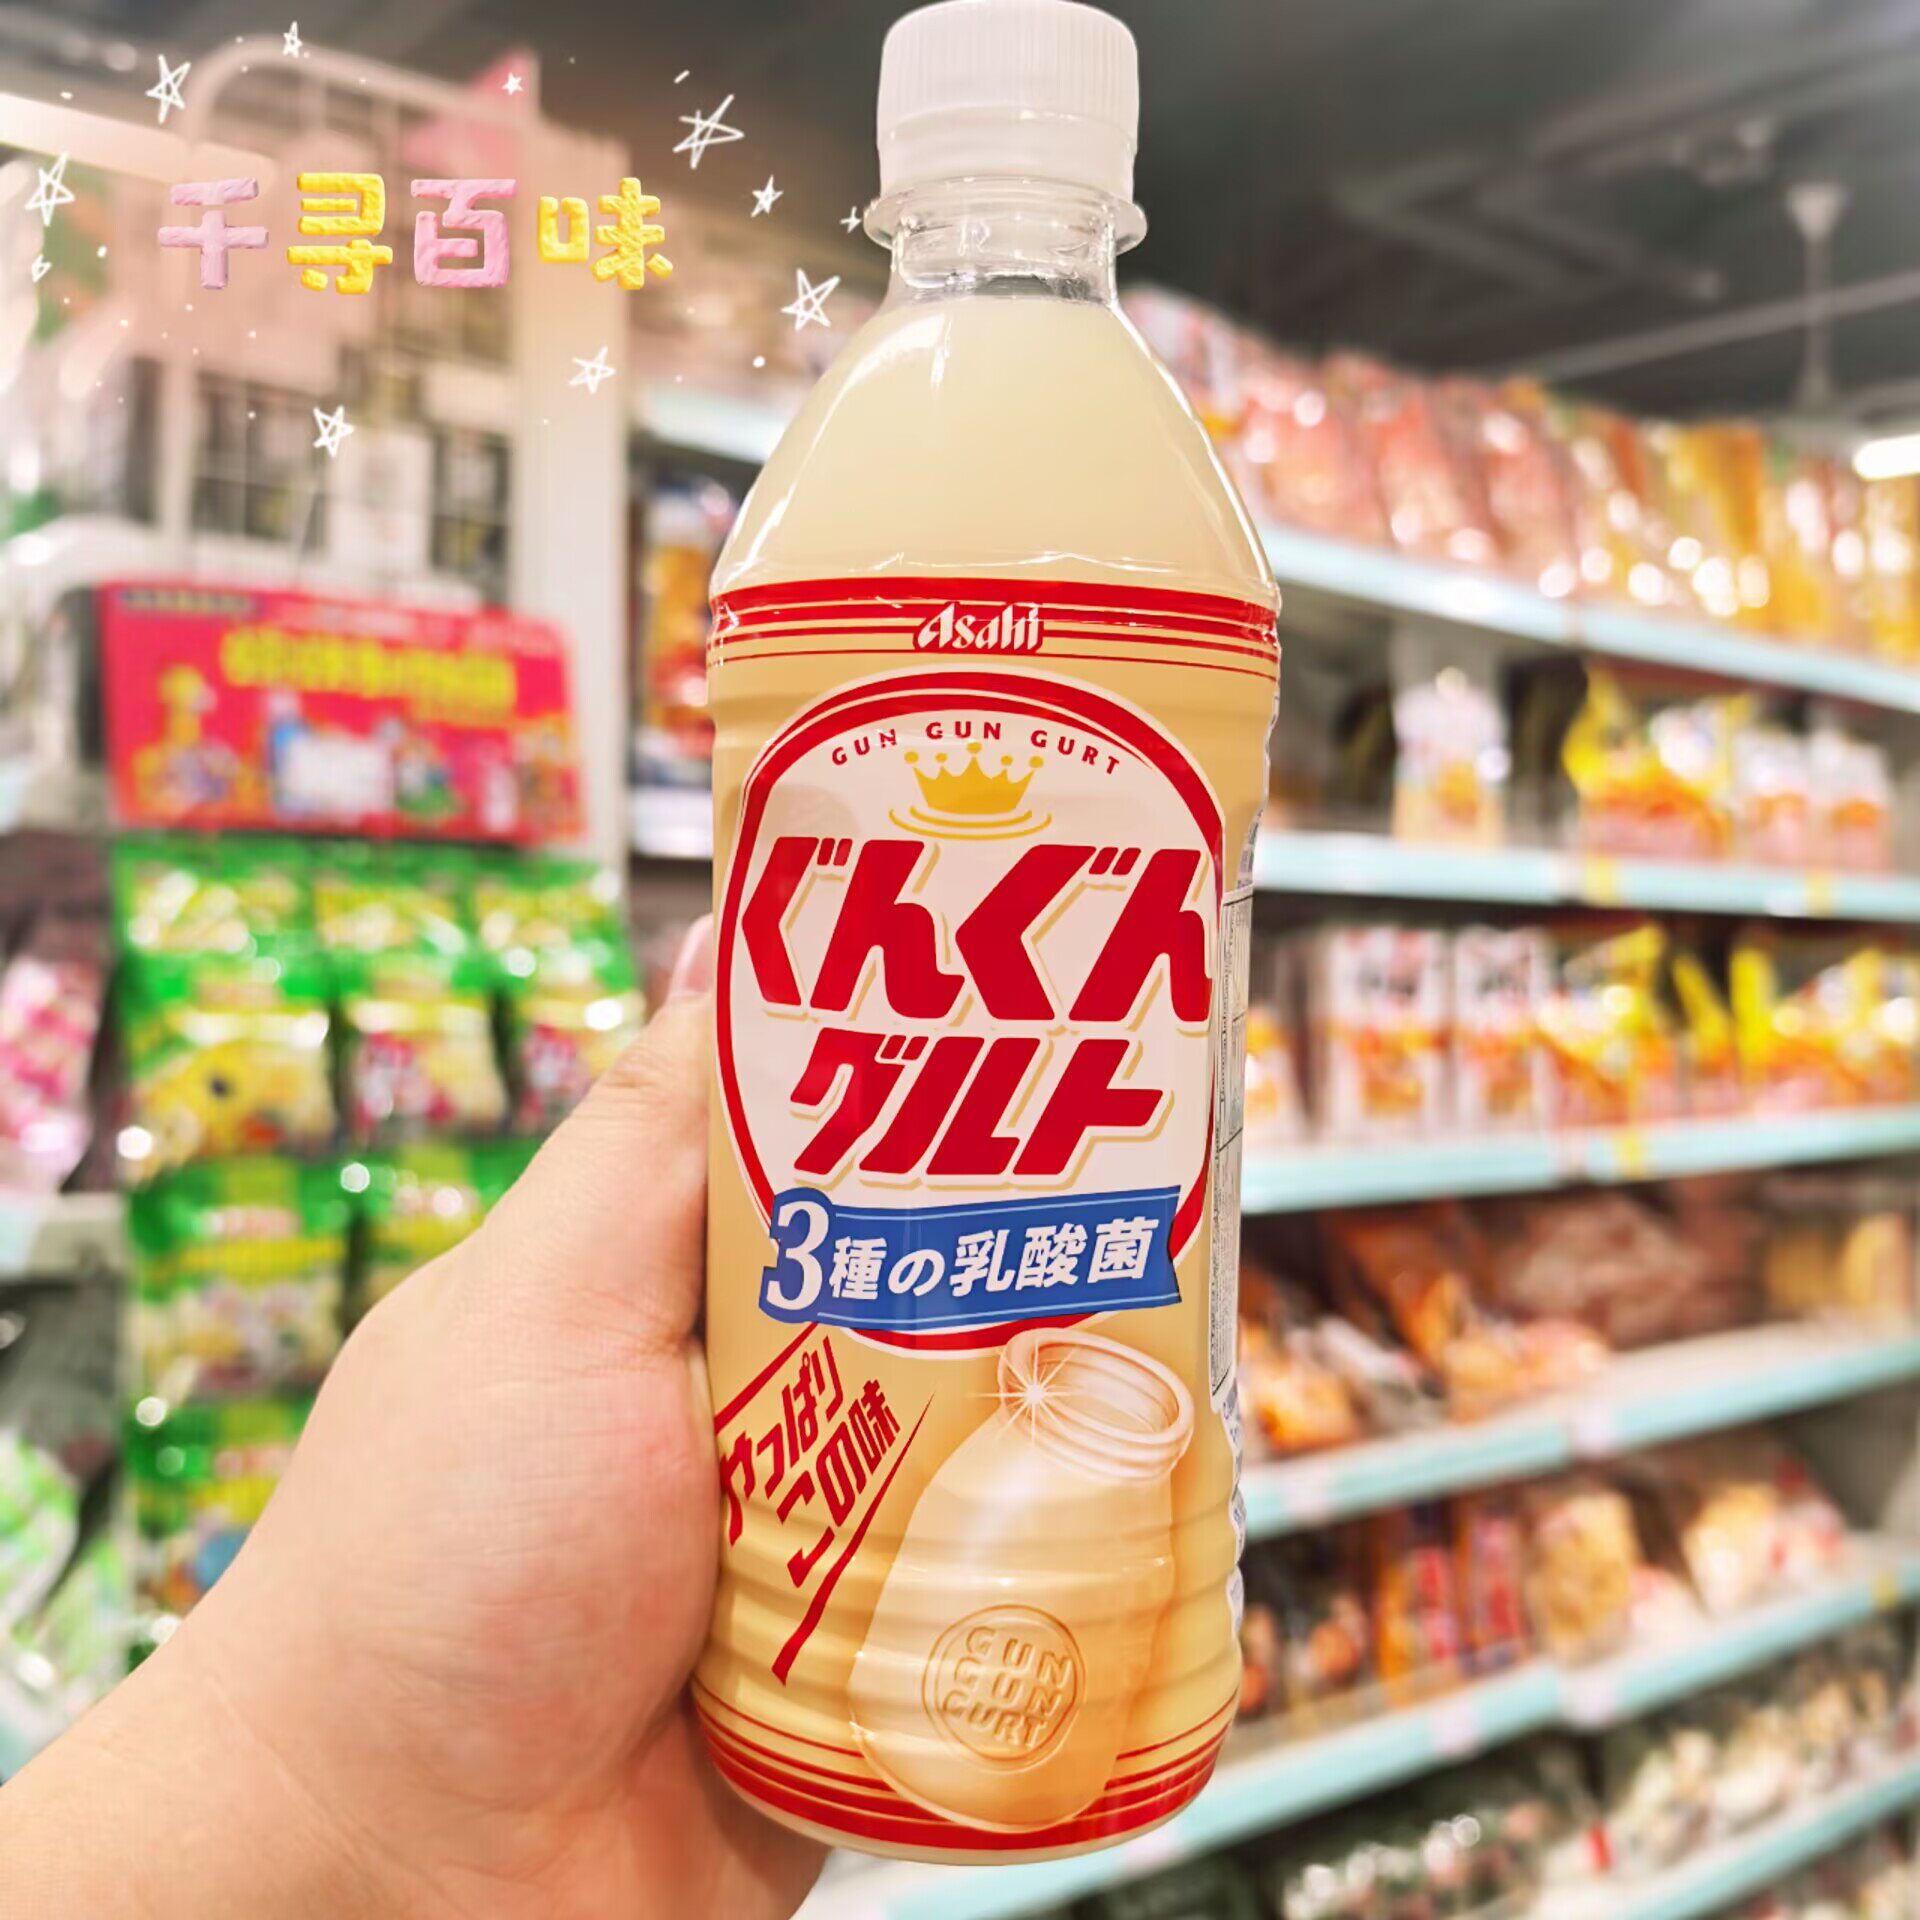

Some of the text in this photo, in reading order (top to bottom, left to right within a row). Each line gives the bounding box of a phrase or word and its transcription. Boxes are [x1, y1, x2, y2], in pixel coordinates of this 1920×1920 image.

[917, 602, 1041, 651] Asahi
[832, 721, 1120, 775] GUN GUN GURT
[741, 836, 1213, 1022] ぐんぐん
[790, 1027, 1164, 1176] グルト
[765, 1200, 1159, 1311] 3種の乳酸菌
[719, 1335, 844, 1547] やっぱり
[776, 1379, 901, 1589] この味
[953, 1656, 1063, 1717] GUN
[966, 1626, 1073, 1689] GUN
[942, 1690, 1049, 1749] GURT
